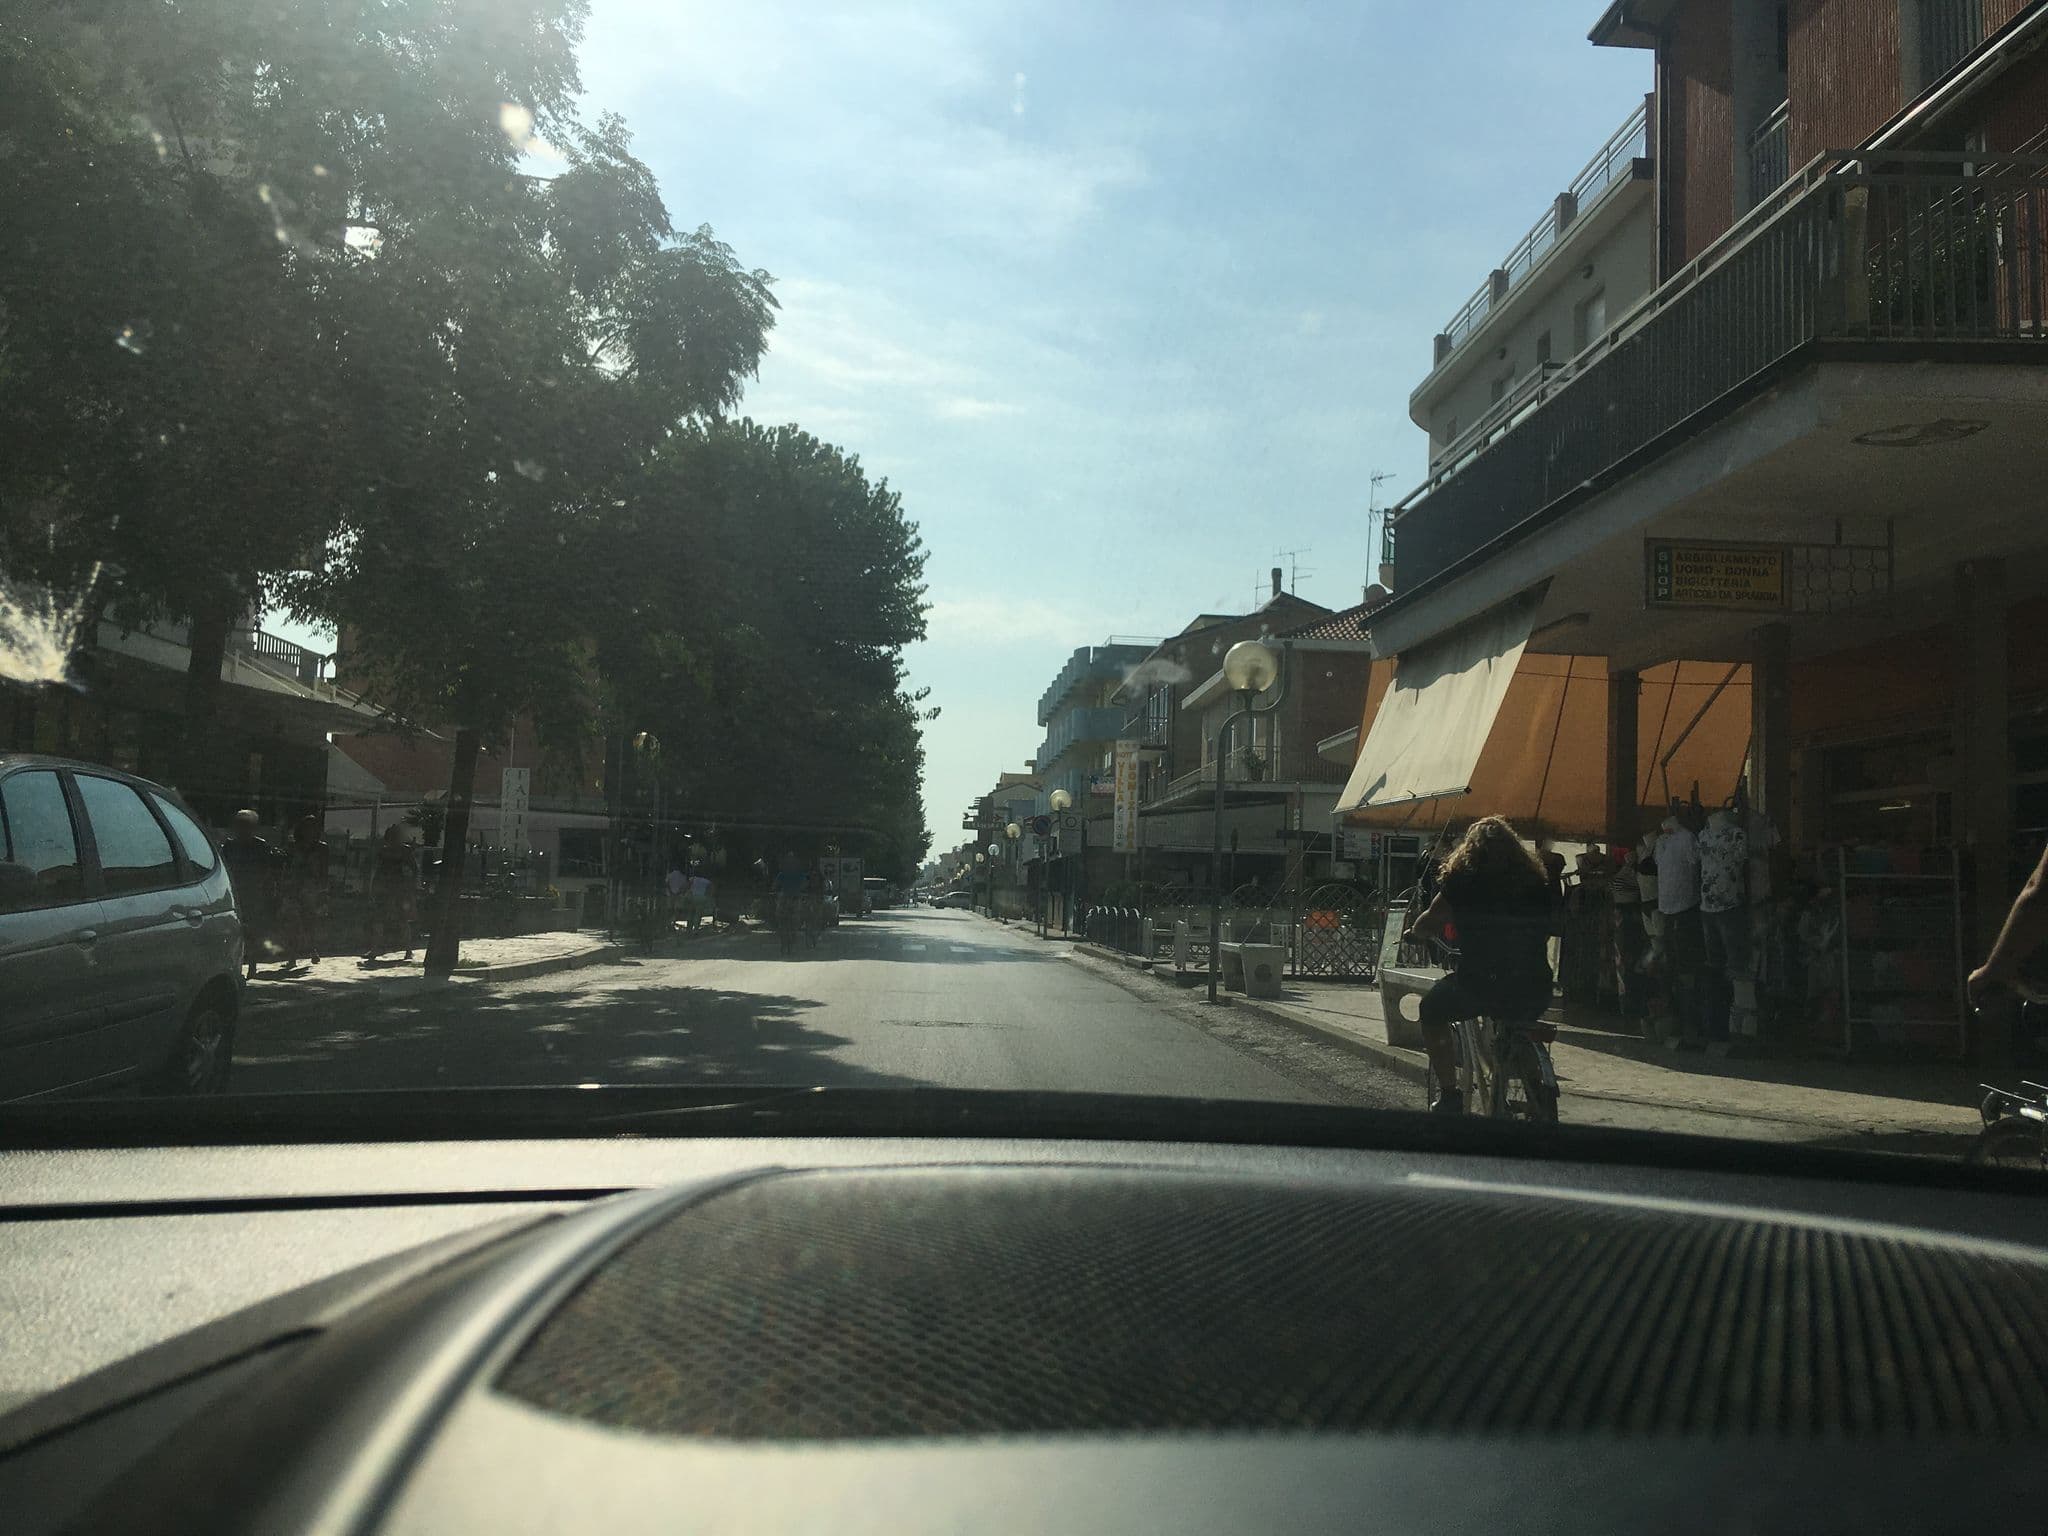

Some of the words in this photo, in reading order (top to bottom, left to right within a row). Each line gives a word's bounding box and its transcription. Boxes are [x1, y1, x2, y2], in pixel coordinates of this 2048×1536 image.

[1658, 552, 1668, 597] SHOP
[1675, 564, 1713, 575] UOMO
[1725, 566, 1769, 577] DONNA
